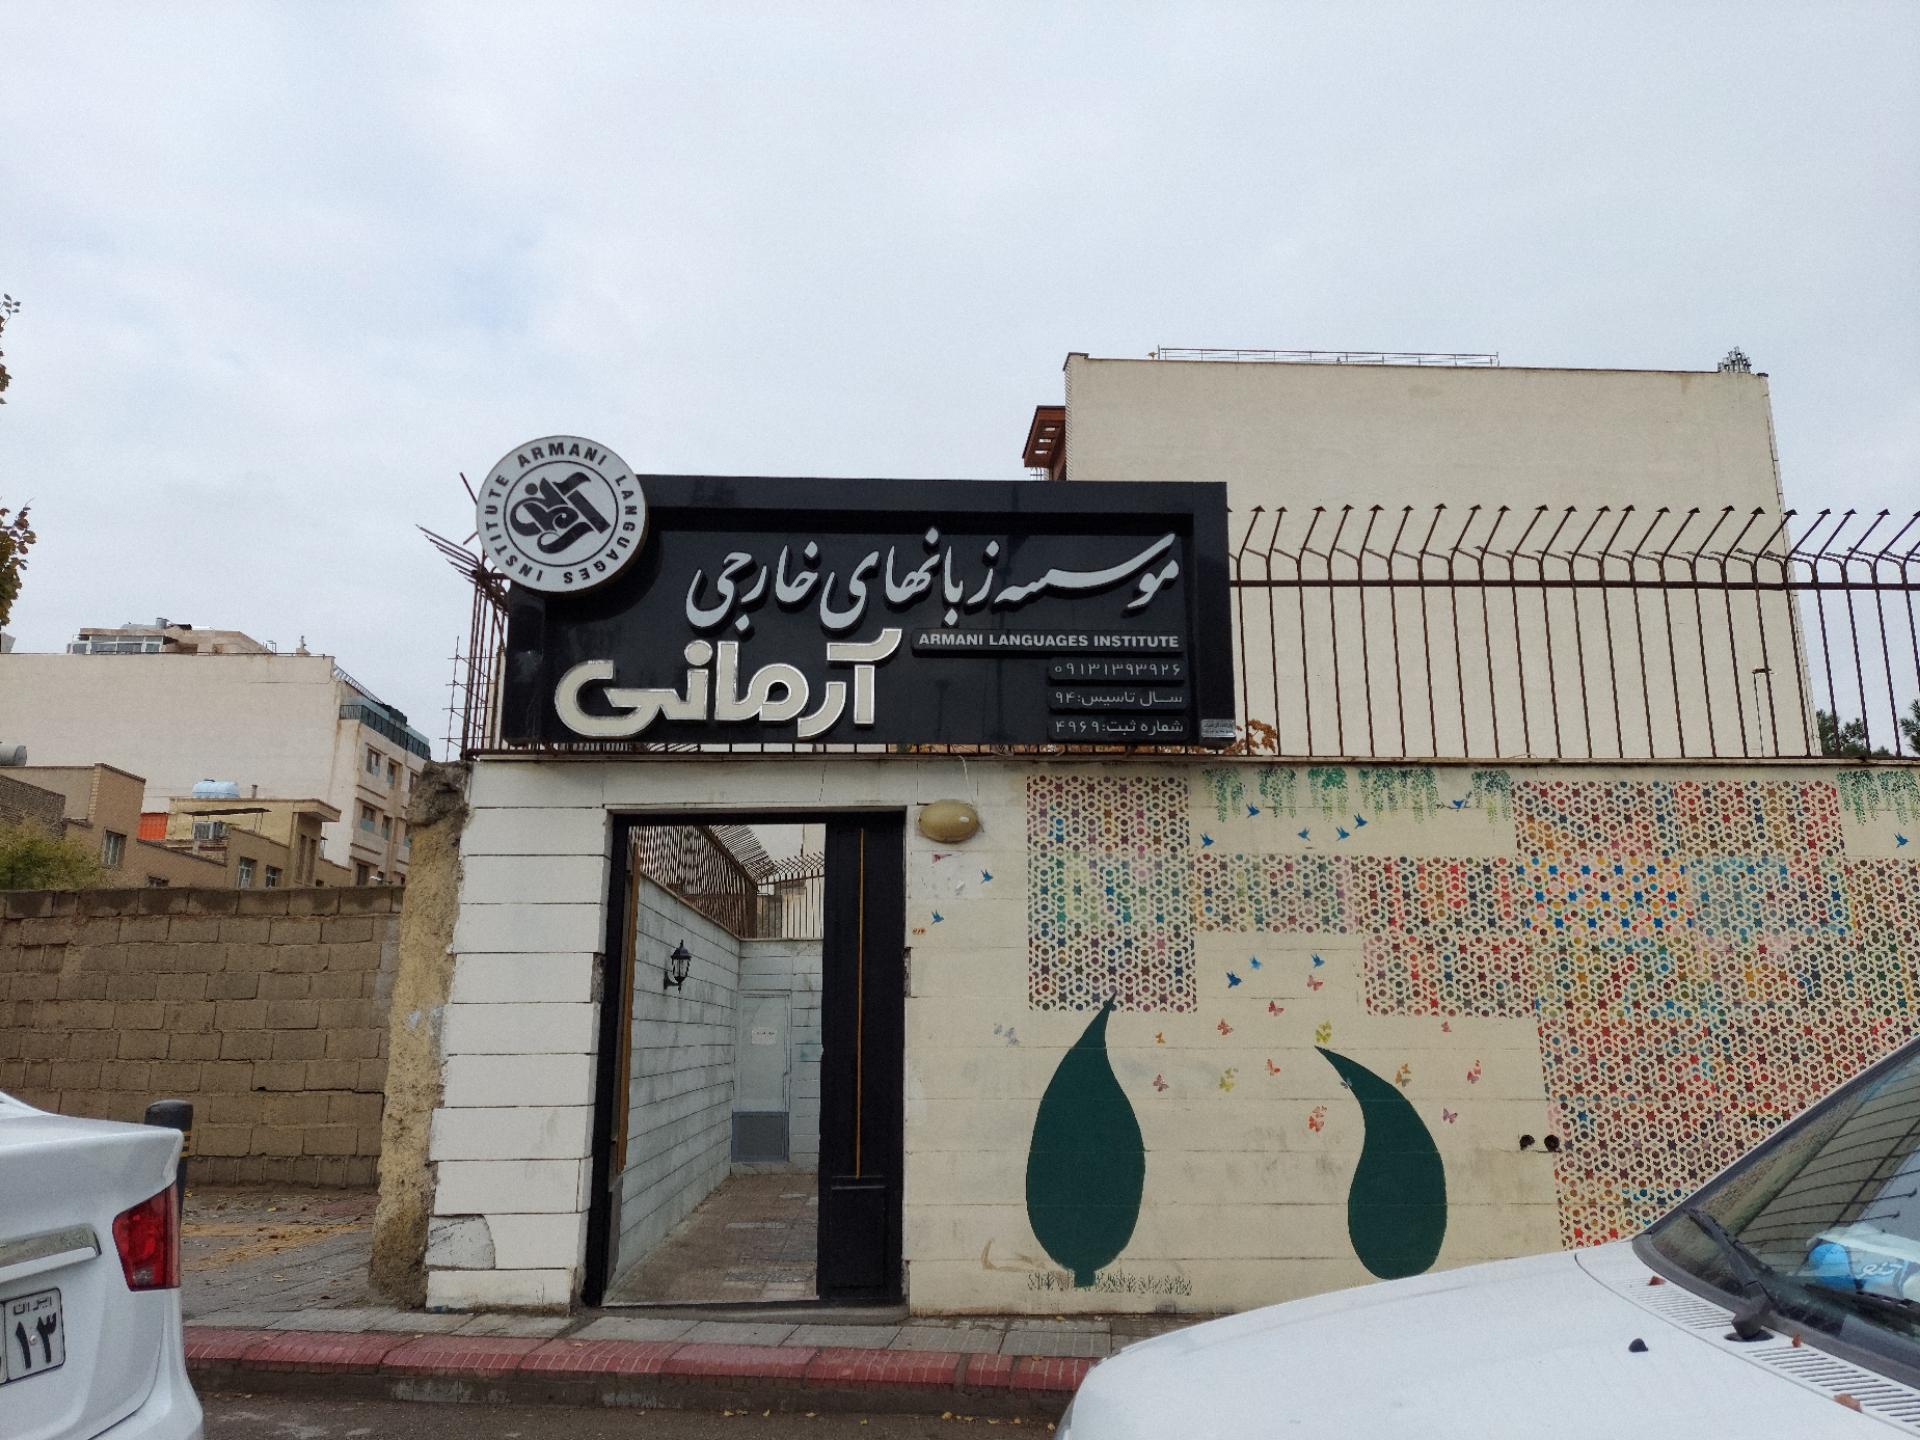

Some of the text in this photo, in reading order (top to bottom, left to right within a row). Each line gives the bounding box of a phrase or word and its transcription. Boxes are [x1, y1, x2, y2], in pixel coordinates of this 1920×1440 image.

[484, 442, 638, 584] ARMANI LANGUAGES INSTITUTE
[686, 541, 818, 631] خارجی
[820, 527, 999, 629] زبانهای
[919, 633, 1179, 648] ARMANI LANGUAGES INSTITUTE
[554, 628, 902, 738] آرمانی
[1140, 690, 1183, 707] سال
[1140, 719, 1184, 736] شماره
[13, 1296, 53, 1316] ایران
[15, 1312, 57, 1369] ۱۳
